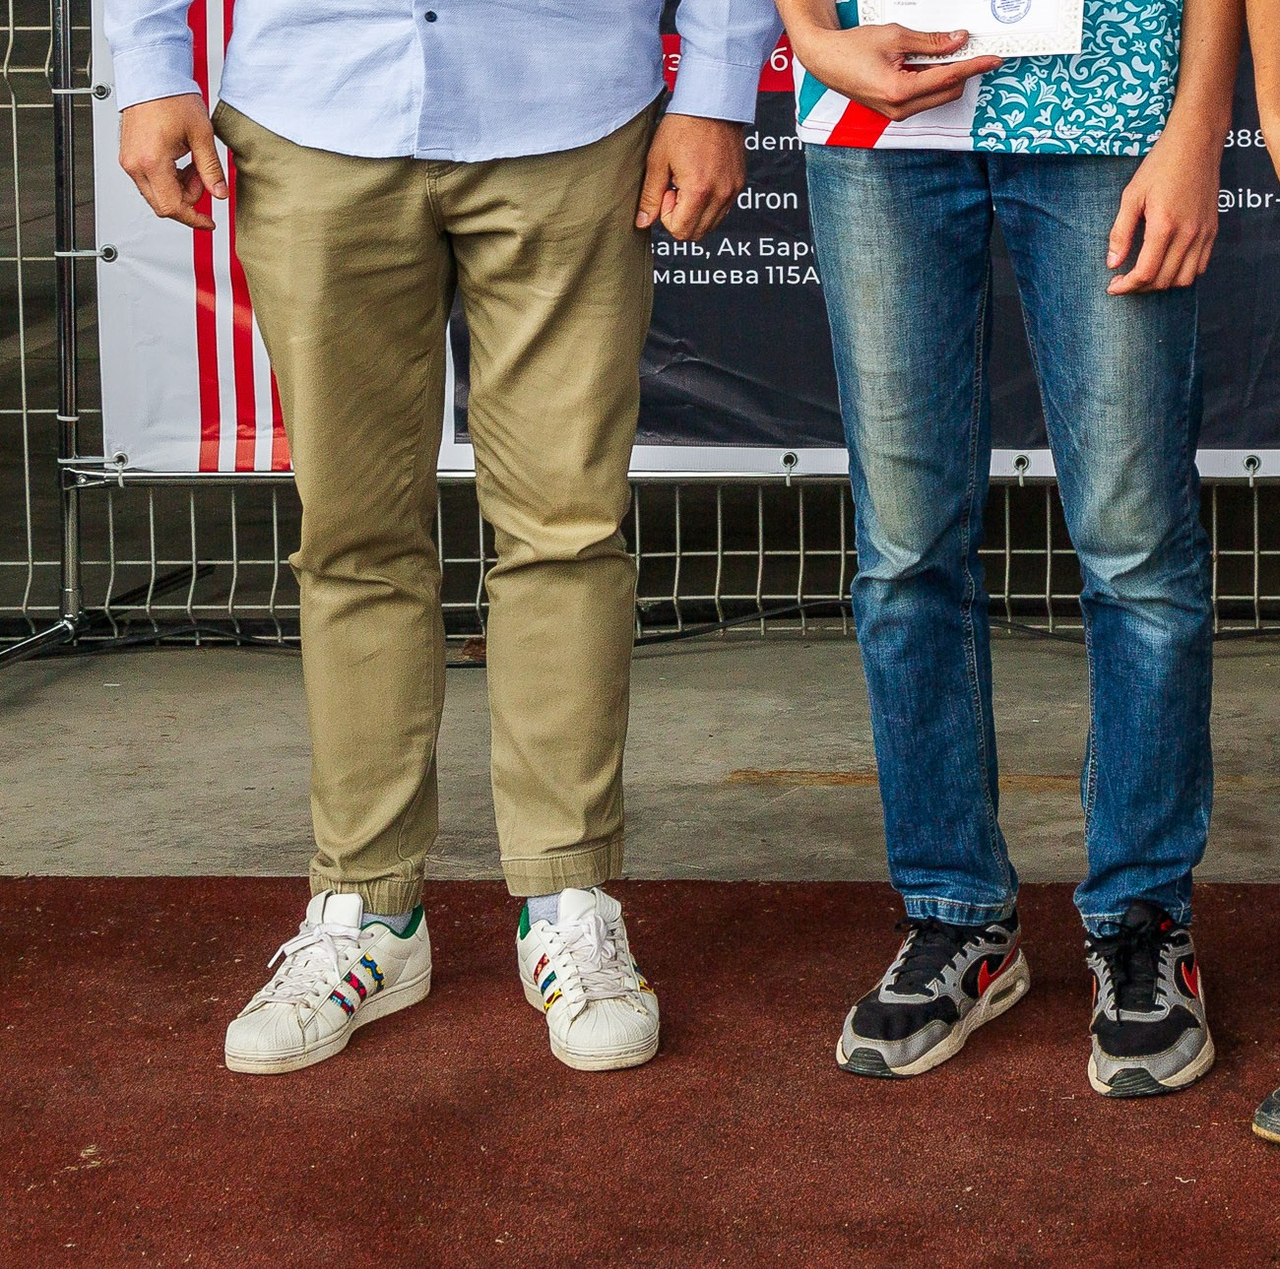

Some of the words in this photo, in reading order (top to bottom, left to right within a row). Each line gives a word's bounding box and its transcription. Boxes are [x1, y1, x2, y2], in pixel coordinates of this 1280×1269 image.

[737, 187, 798, 210] dron
[717, 237, 751, 256] Ак
[759, 237, 814, 261] Бар
[653, 269, 759, 285] машева
